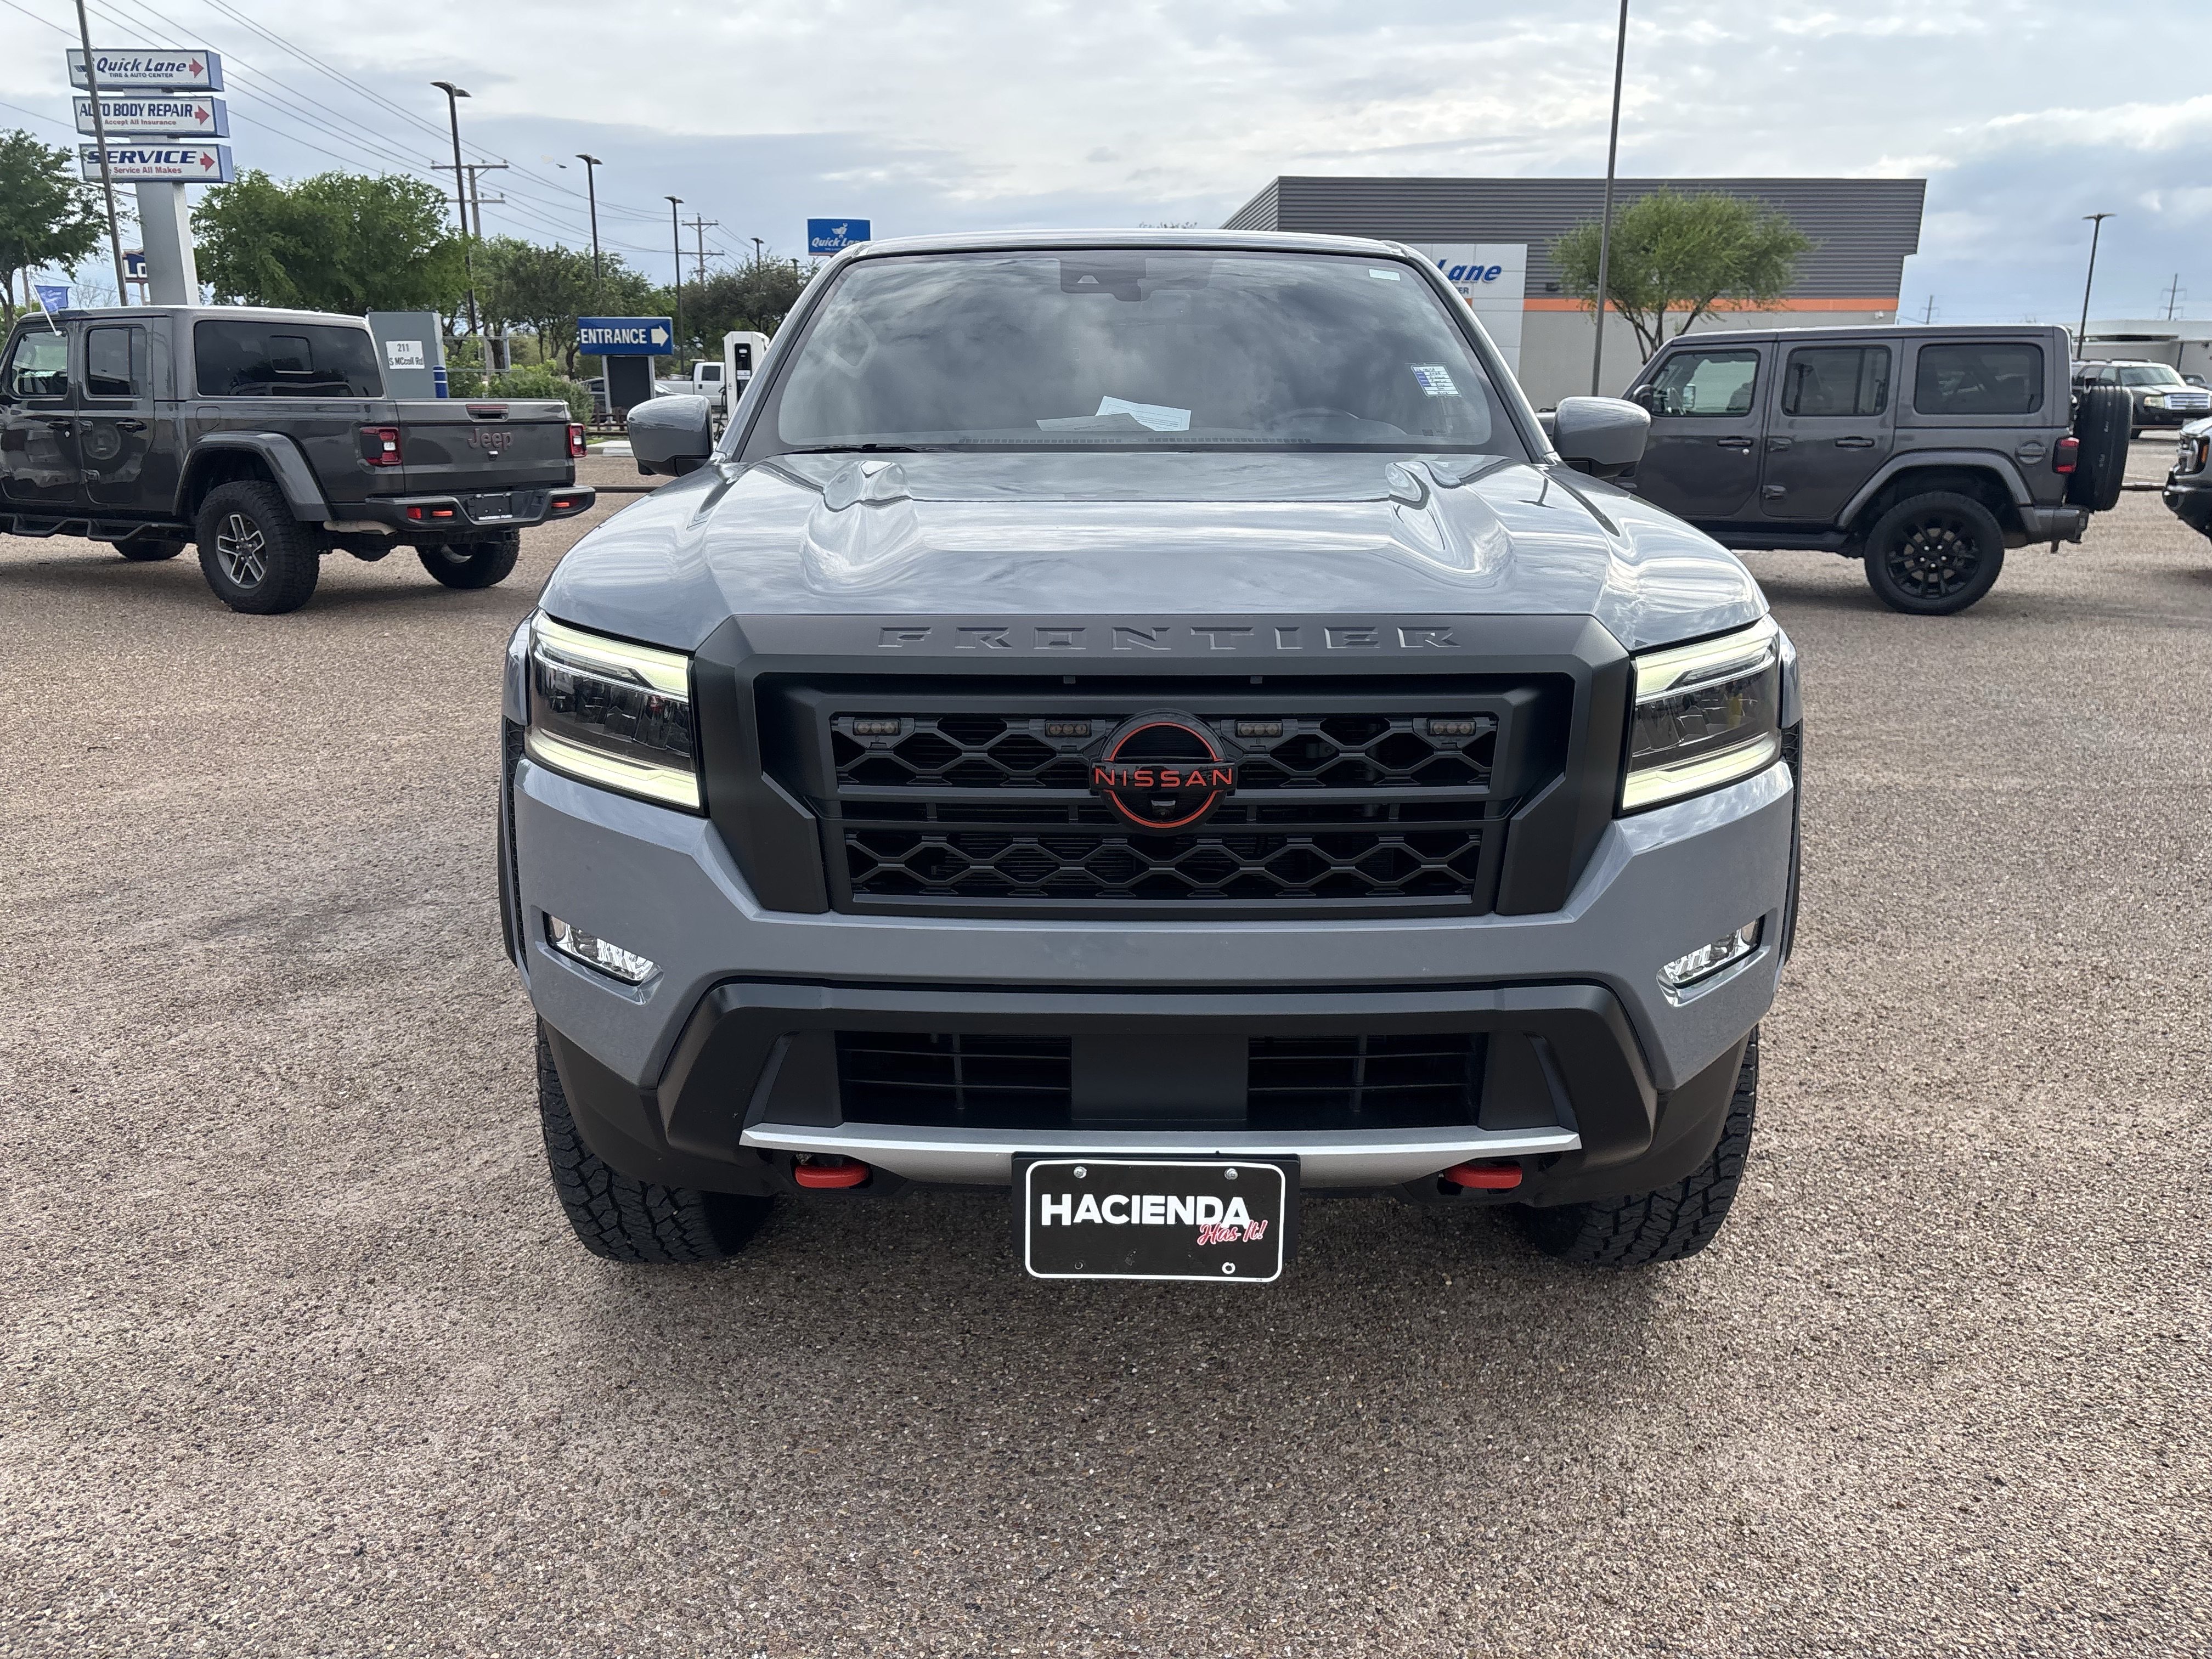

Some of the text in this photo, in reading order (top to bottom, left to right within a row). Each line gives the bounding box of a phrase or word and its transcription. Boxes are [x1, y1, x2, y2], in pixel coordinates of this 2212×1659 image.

[97, 57, 187, 72] Quick Lane
[113, 103, 146, 117] BODY
[148, 103, 193, 117] REPAIR
[87, 150, 197, 164] SERVICE
[812, 236, 840, 247] Quick
[580, 328, 647, 344] ENTRANCE
[397, 343, 409, 352] 211
[388, 357, 394, 366] S
[415, 356, 425, 365] Rd
[466, 427, 513, 451] Jeep
[877, 627, 1462, 651] FRONTIER
[1094, 768, 1233, 787] NISSAN
[1042, 1193, 1251, 1229] HACIENDA
[1197, 1219, 1268, 1245] Has It!
